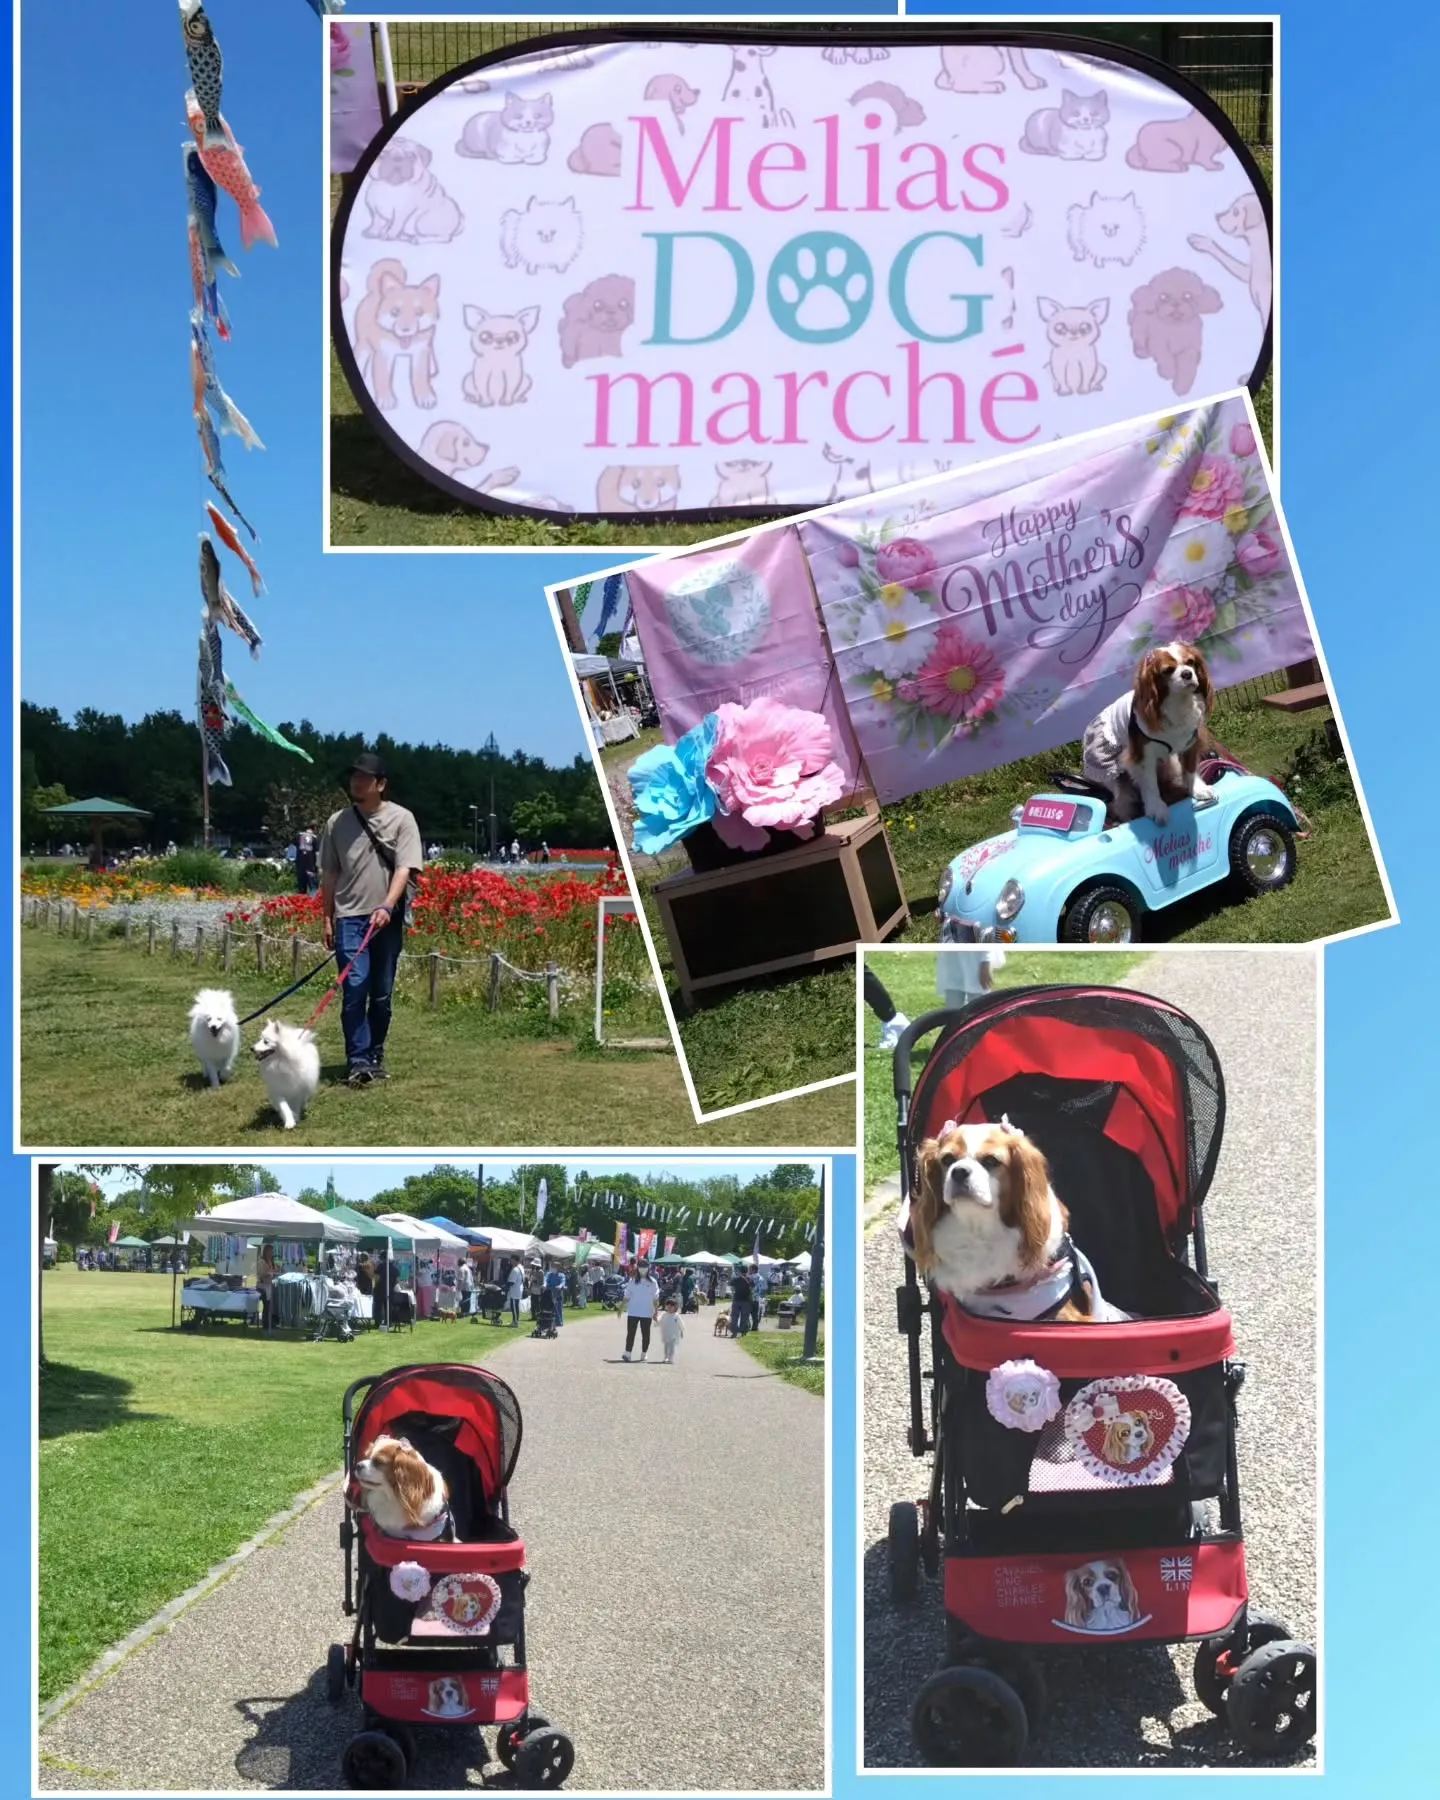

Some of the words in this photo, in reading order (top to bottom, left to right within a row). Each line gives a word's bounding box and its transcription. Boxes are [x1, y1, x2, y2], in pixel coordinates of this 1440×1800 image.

[622, 112, 1010, 213] Melias
[639, 230, 994, 346] DOG
[583, 340, 1042, 448] marché
[982, 497, 1082, 559] Happy
[1033, 806, 1057, 820] MELIAS
[1144, 832, 1191, 863] Melias
[1169, 832, 1212, 870] marché
